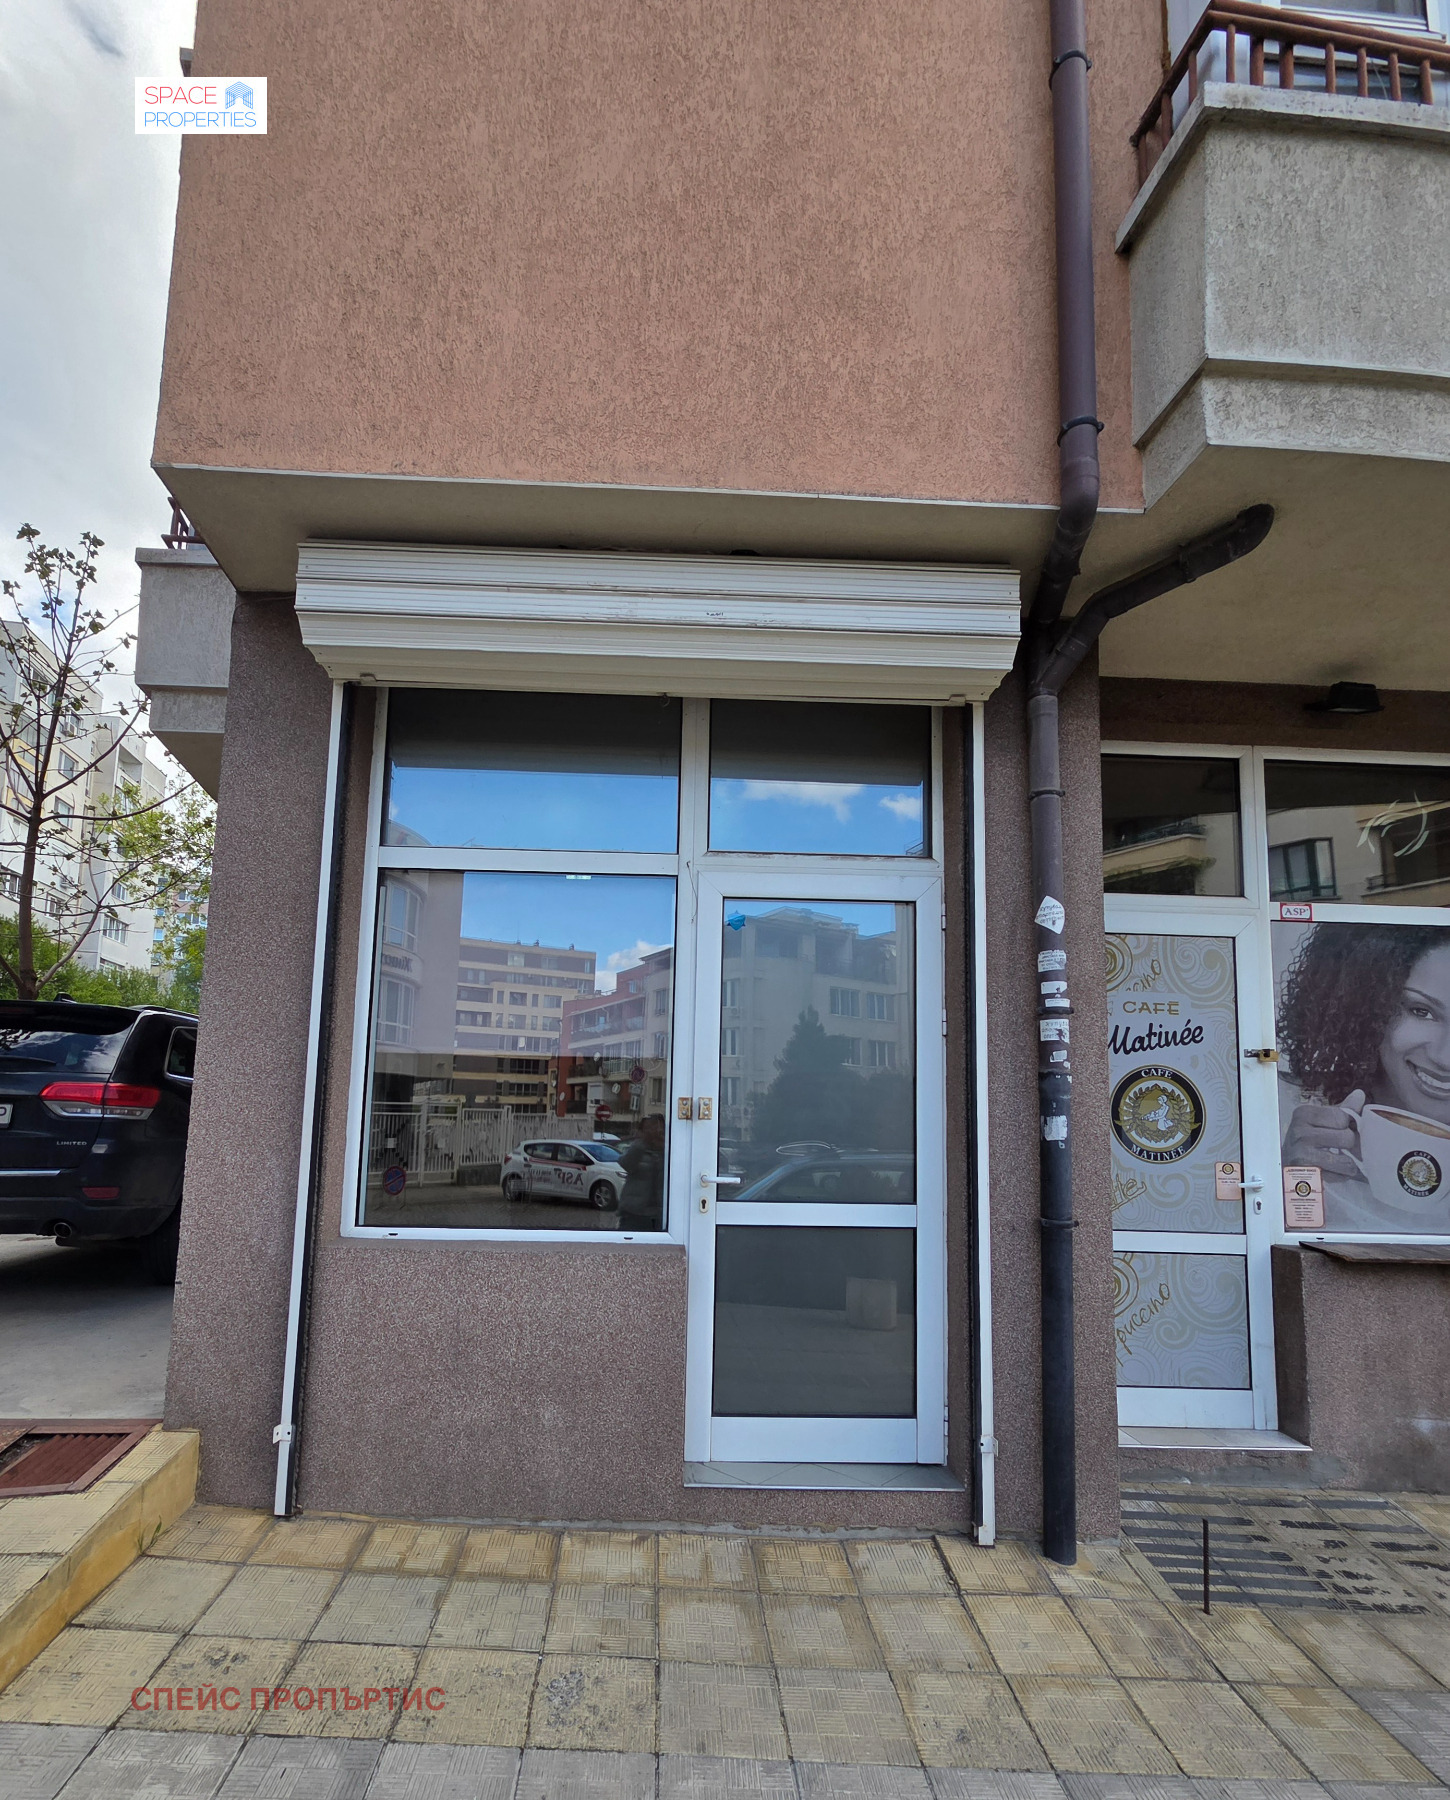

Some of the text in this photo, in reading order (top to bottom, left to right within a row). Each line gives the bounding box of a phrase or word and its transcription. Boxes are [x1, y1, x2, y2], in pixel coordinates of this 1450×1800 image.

[1284, 907, 1306, 916] ASP
[1107, 1019, 1204, 1055] Matinée
[1141, 1068, 1173, 1079] CAFE
